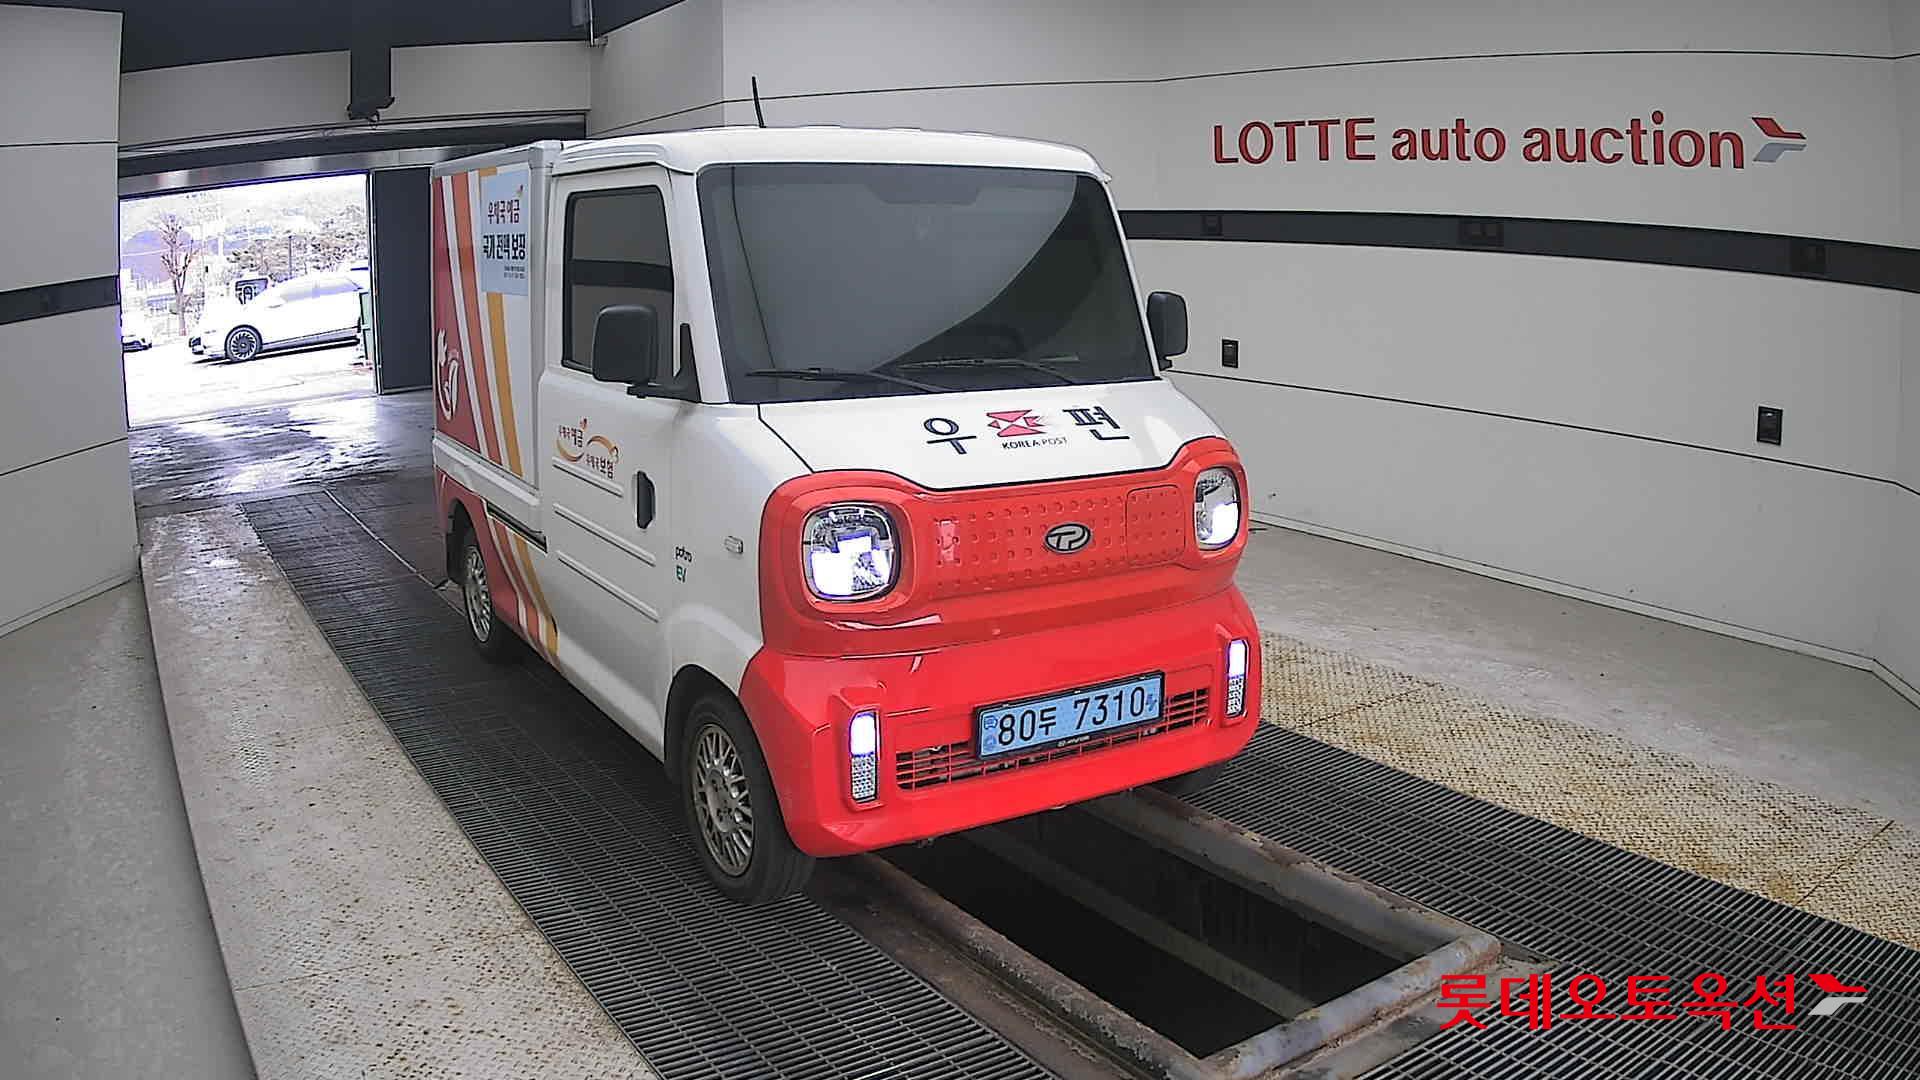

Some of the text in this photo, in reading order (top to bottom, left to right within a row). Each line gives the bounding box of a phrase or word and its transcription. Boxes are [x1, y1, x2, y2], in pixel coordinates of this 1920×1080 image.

[1213, 110, 1744, 169] LOTTE auto auction
[1002, 436, 1068, 450] KOREA POST
[998, 686, 1146, 746] 80두 7310
